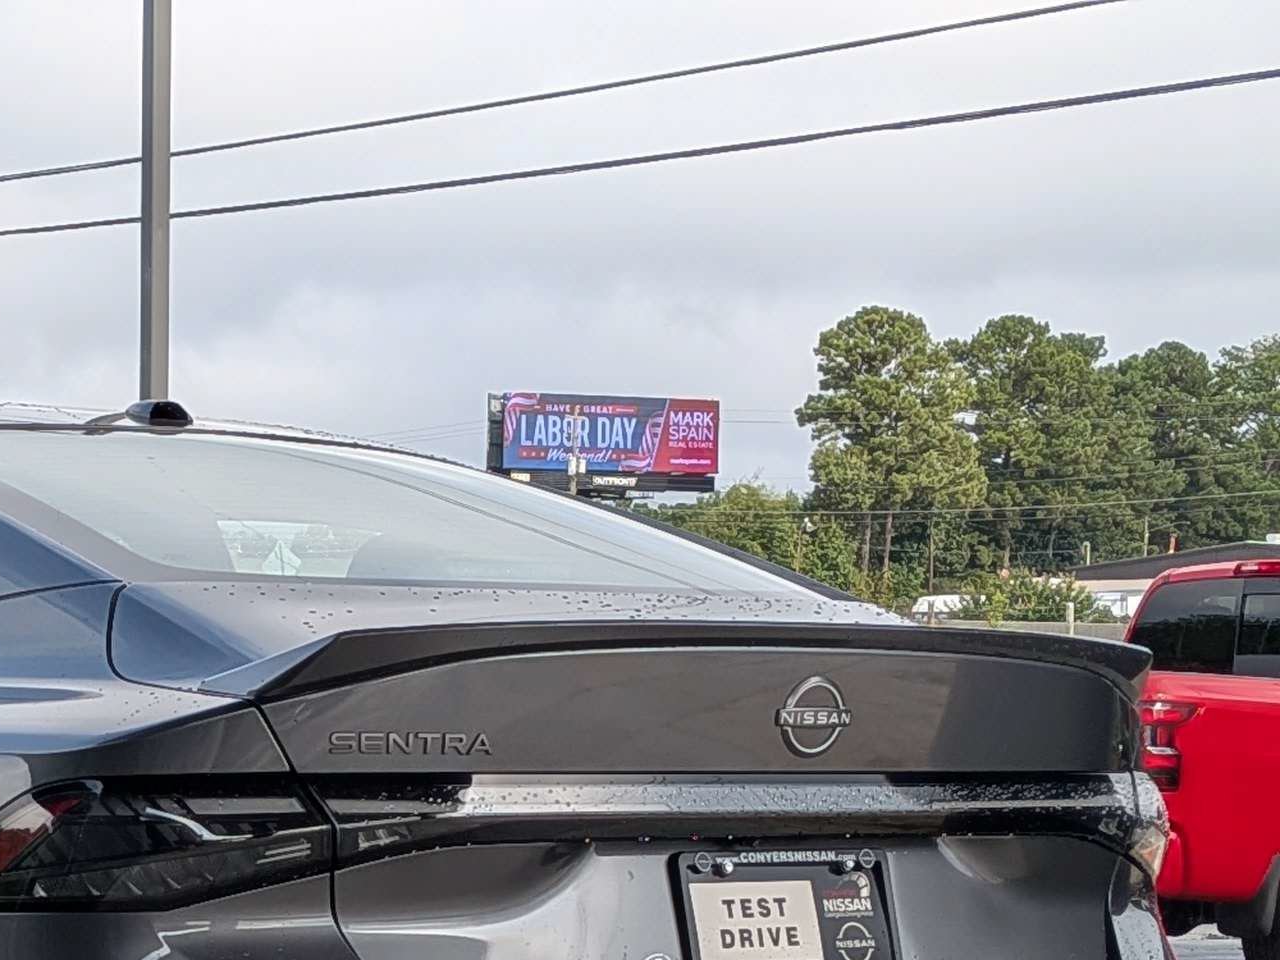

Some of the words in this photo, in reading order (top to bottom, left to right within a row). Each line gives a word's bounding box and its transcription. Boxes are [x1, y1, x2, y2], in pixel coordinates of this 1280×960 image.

[545, 404, 570, 413] HAVE
[583, 405, 613, 414] GREAT
[669, 411, 714, 427] MARK
[520, 414, 589, 448] LABOR
[597, 417, 637, 449] DAY
[669, 426, 714, 441] SPAIN
[668, 441, 687, 449] REAL
[780, 710, 851, 725] NISSAN
[328, 730, 494, 756] SENTRA
[721, 897, 787, 919] TEST
[822, 898, 872, 912] NISSAN
[719, 926, 801, 949] DRIVE
[835, 939, 875, 949] NISSAN
